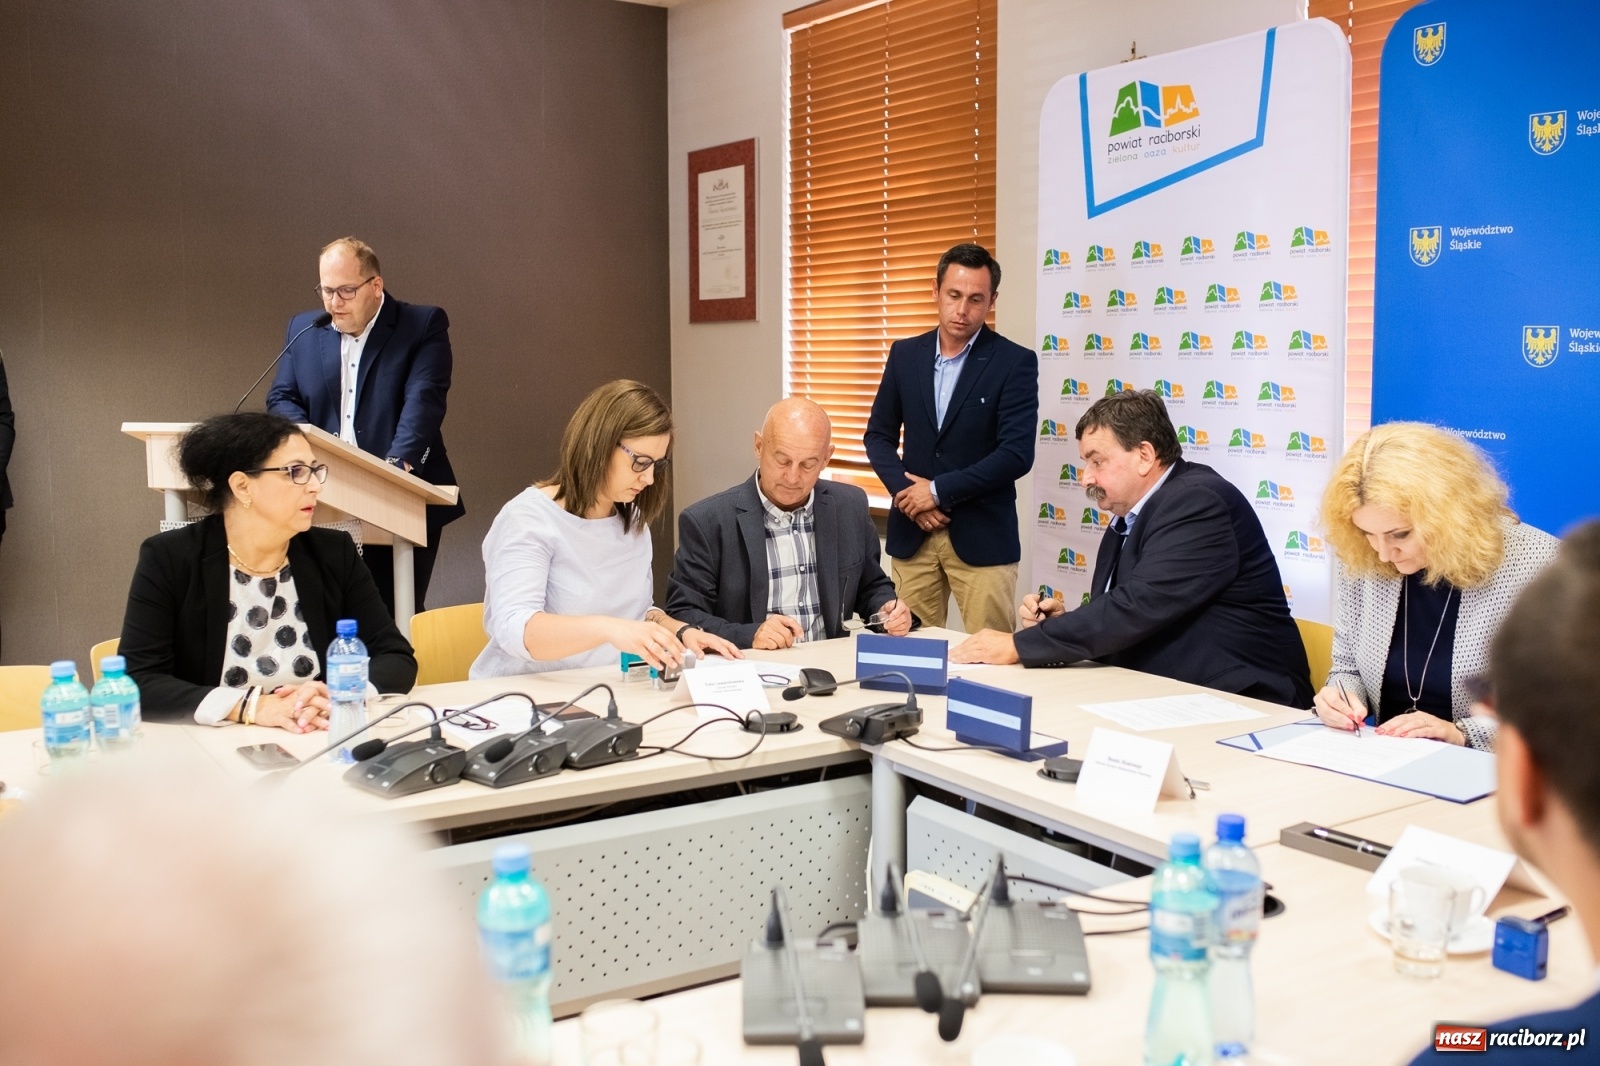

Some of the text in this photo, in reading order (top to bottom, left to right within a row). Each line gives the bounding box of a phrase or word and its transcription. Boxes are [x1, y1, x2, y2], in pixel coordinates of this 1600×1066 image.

[1107, 124, 1201, 156] powiat raciborski
[1107, 143, 1201, 164] zielona oaza kultur
[1450, 225, 1514, 238] Województwo
[1449, 239, 1482, 252] Śląskie
[1568, 341, 1600, 355] Śląski
